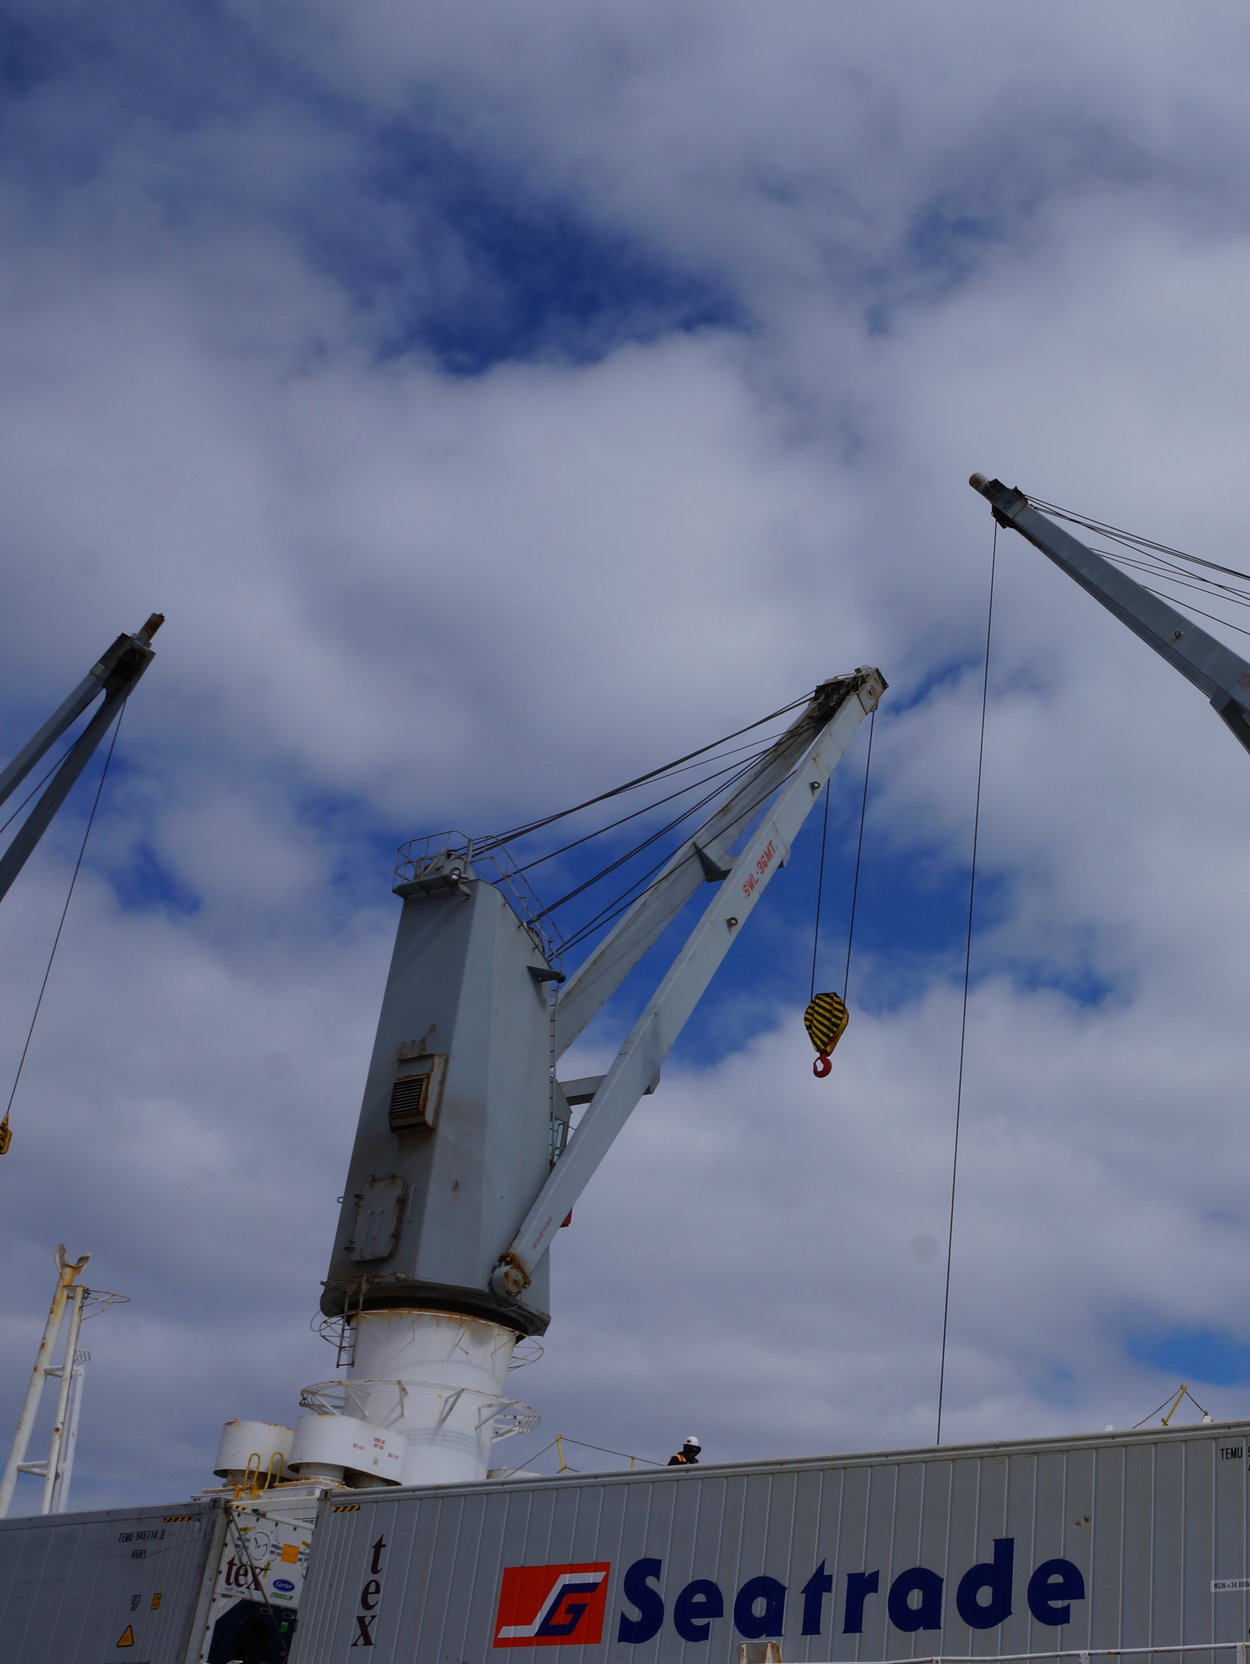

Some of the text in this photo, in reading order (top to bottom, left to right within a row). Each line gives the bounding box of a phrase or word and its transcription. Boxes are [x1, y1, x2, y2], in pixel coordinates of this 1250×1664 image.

[1220, 1446, 1243, 1460] TEMU
[225, 1555, 269, 1592] tex
[351, 1534, 387, 1647] tex
[617, 1538, 1086, 1644] Seatrade
